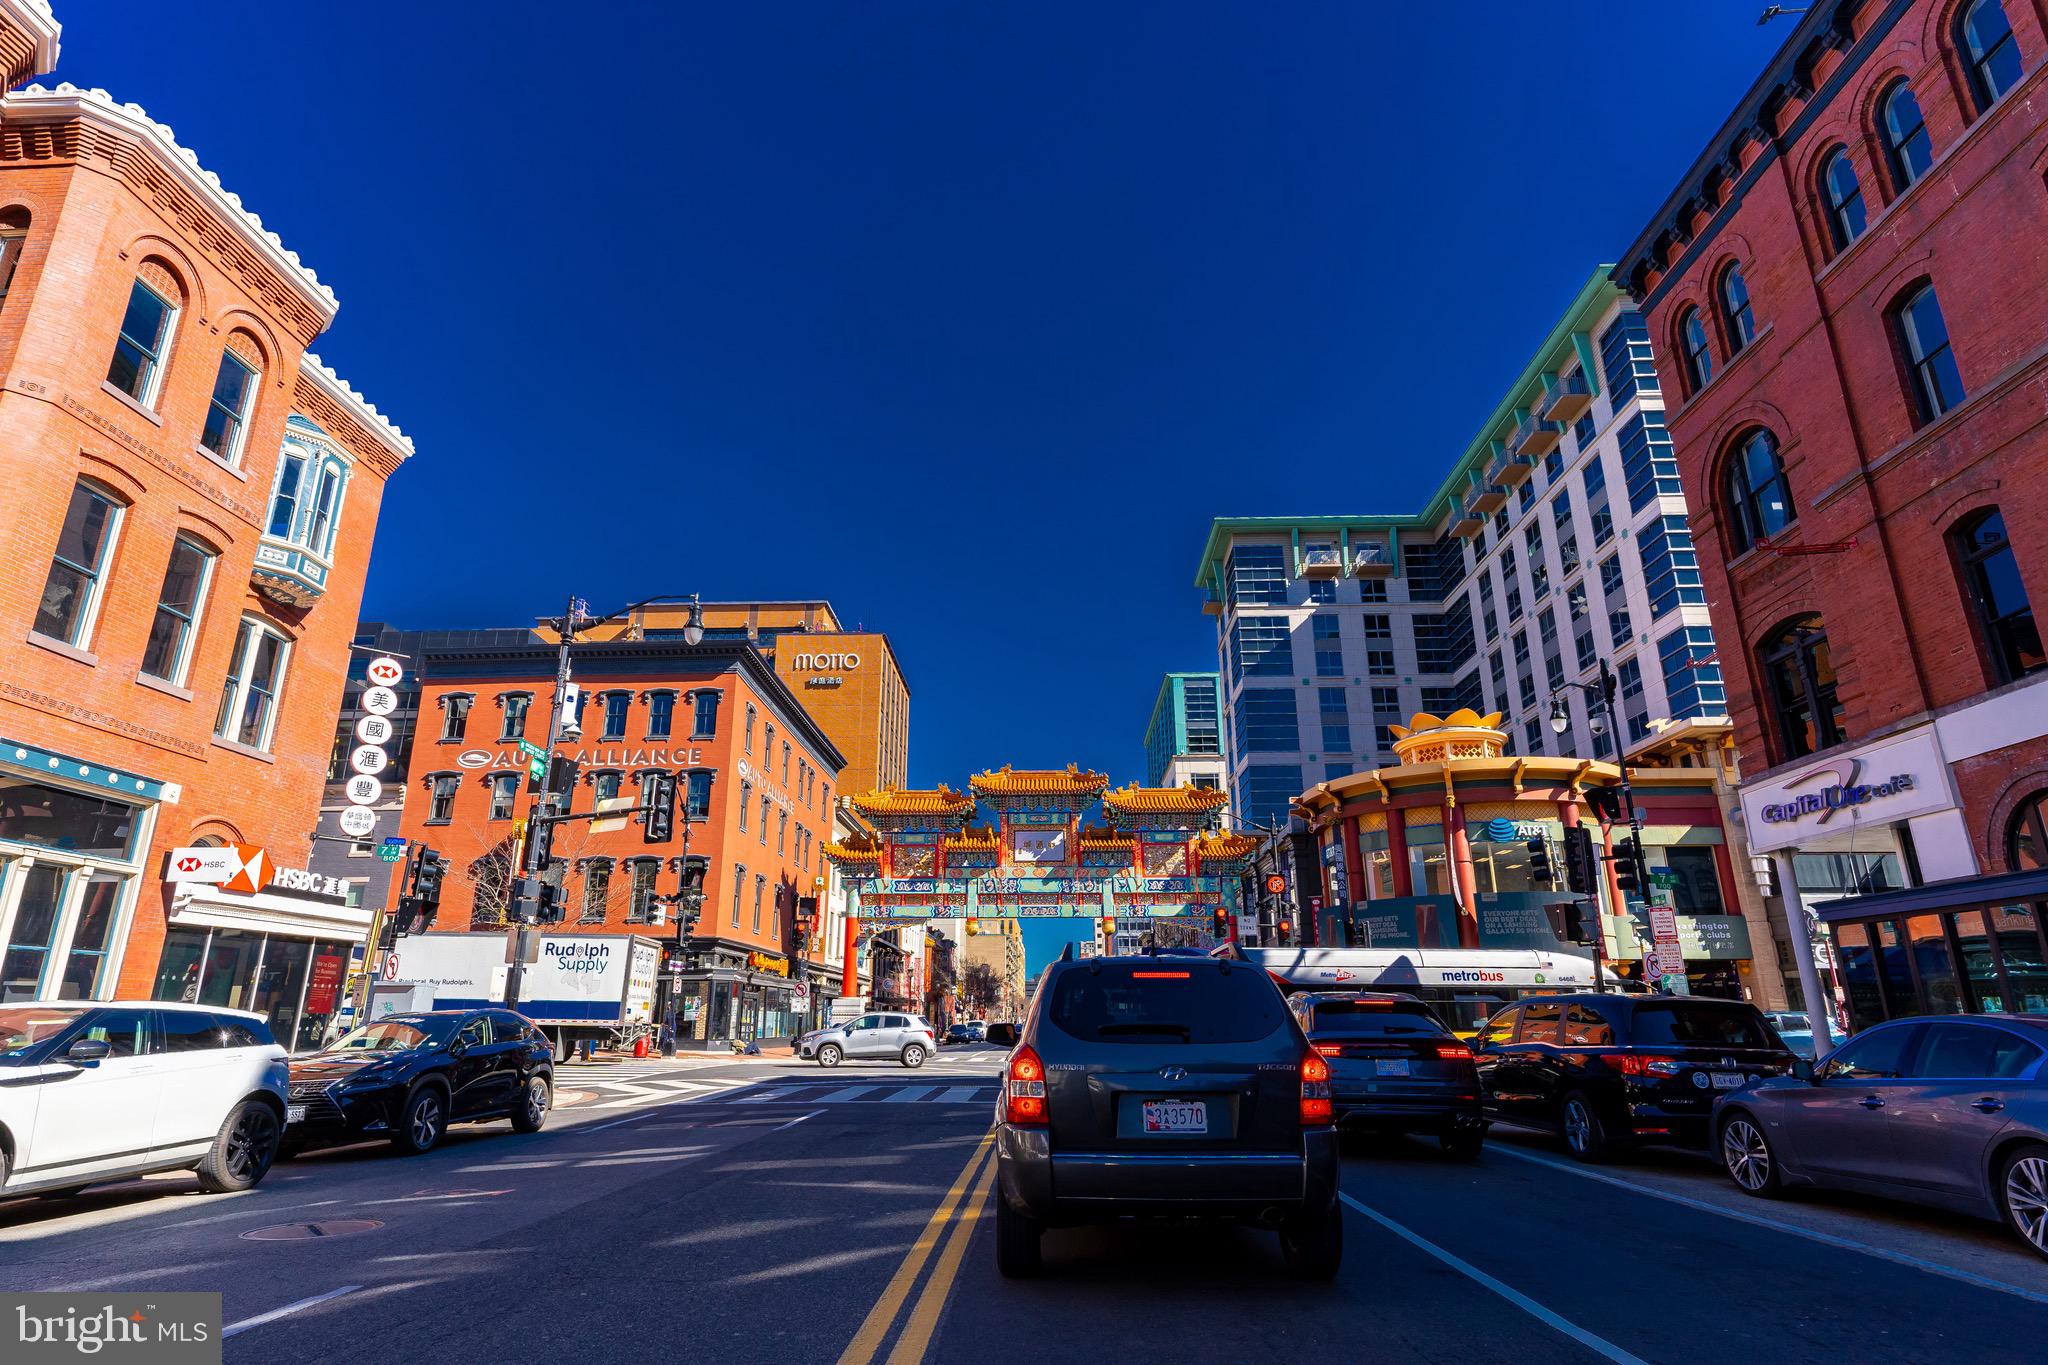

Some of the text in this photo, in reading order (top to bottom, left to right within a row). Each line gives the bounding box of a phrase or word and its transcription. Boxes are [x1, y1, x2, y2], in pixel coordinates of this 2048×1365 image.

[574, 747, 701, 768] ALLIANCE
[747, 764, 795, 815] AUTO ALLIANCE
[1518, 825, 1548, 837] AT&T
[381, 846, 388, 855] 7
[203, 860, 226, 869] HSBC
[273, 866, 322, 893] HSBC
[1659, 875, 1666, 883] 7
[1706, 931, 1731, 939] clubs
[557, 956, 608, 974] Supply
[1441, 969, 1504, 982] metrobus
[429, 978, 440, 986] Buy
[1048, 1063, 1085, 1071] HYUNDAI
[1257, 1063, 1296, 1071] TUCSON
